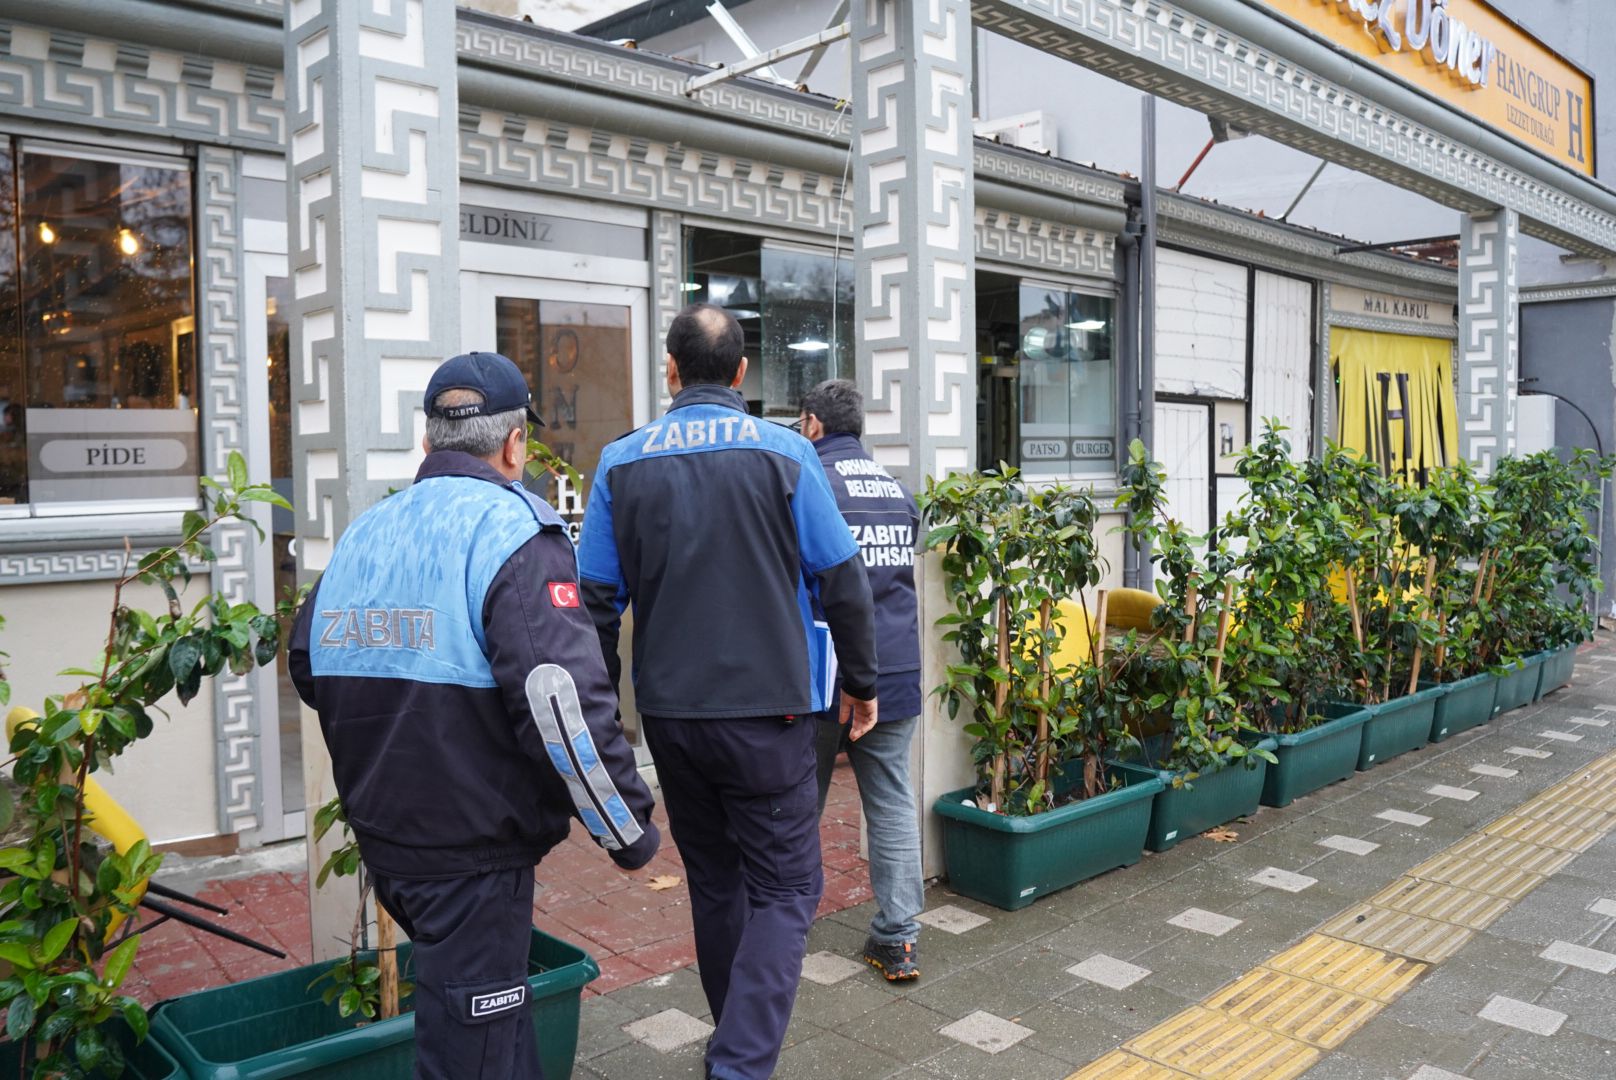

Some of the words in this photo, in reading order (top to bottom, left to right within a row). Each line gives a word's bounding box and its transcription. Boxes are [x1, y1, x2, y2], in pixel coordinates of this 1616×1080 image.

[1494, 49, 1561, 121] HANGRUP
[1506, 103, 1529, 133] LEZZET
[1566, 89, 1585, 163] H
[459, 211, 553, 243] ELDİNİZ
[1363, 297, 1389, 314] MAL
[1393, 299, 1430, 320] KABUL
[448, 405, 481, 417] ZABITA
[641, 416, 761, 454] ZABITA
[85, 443, 146, 466] PİDE
[1029, 443, 1060, 455] PATSO
[1075, 442, 1110, 454] BURGER
[861, 546, 915, 567] UHSAT
[319, 608, 436, 651] ZABITA
[480, 993, 520, 1009] ZABITA
